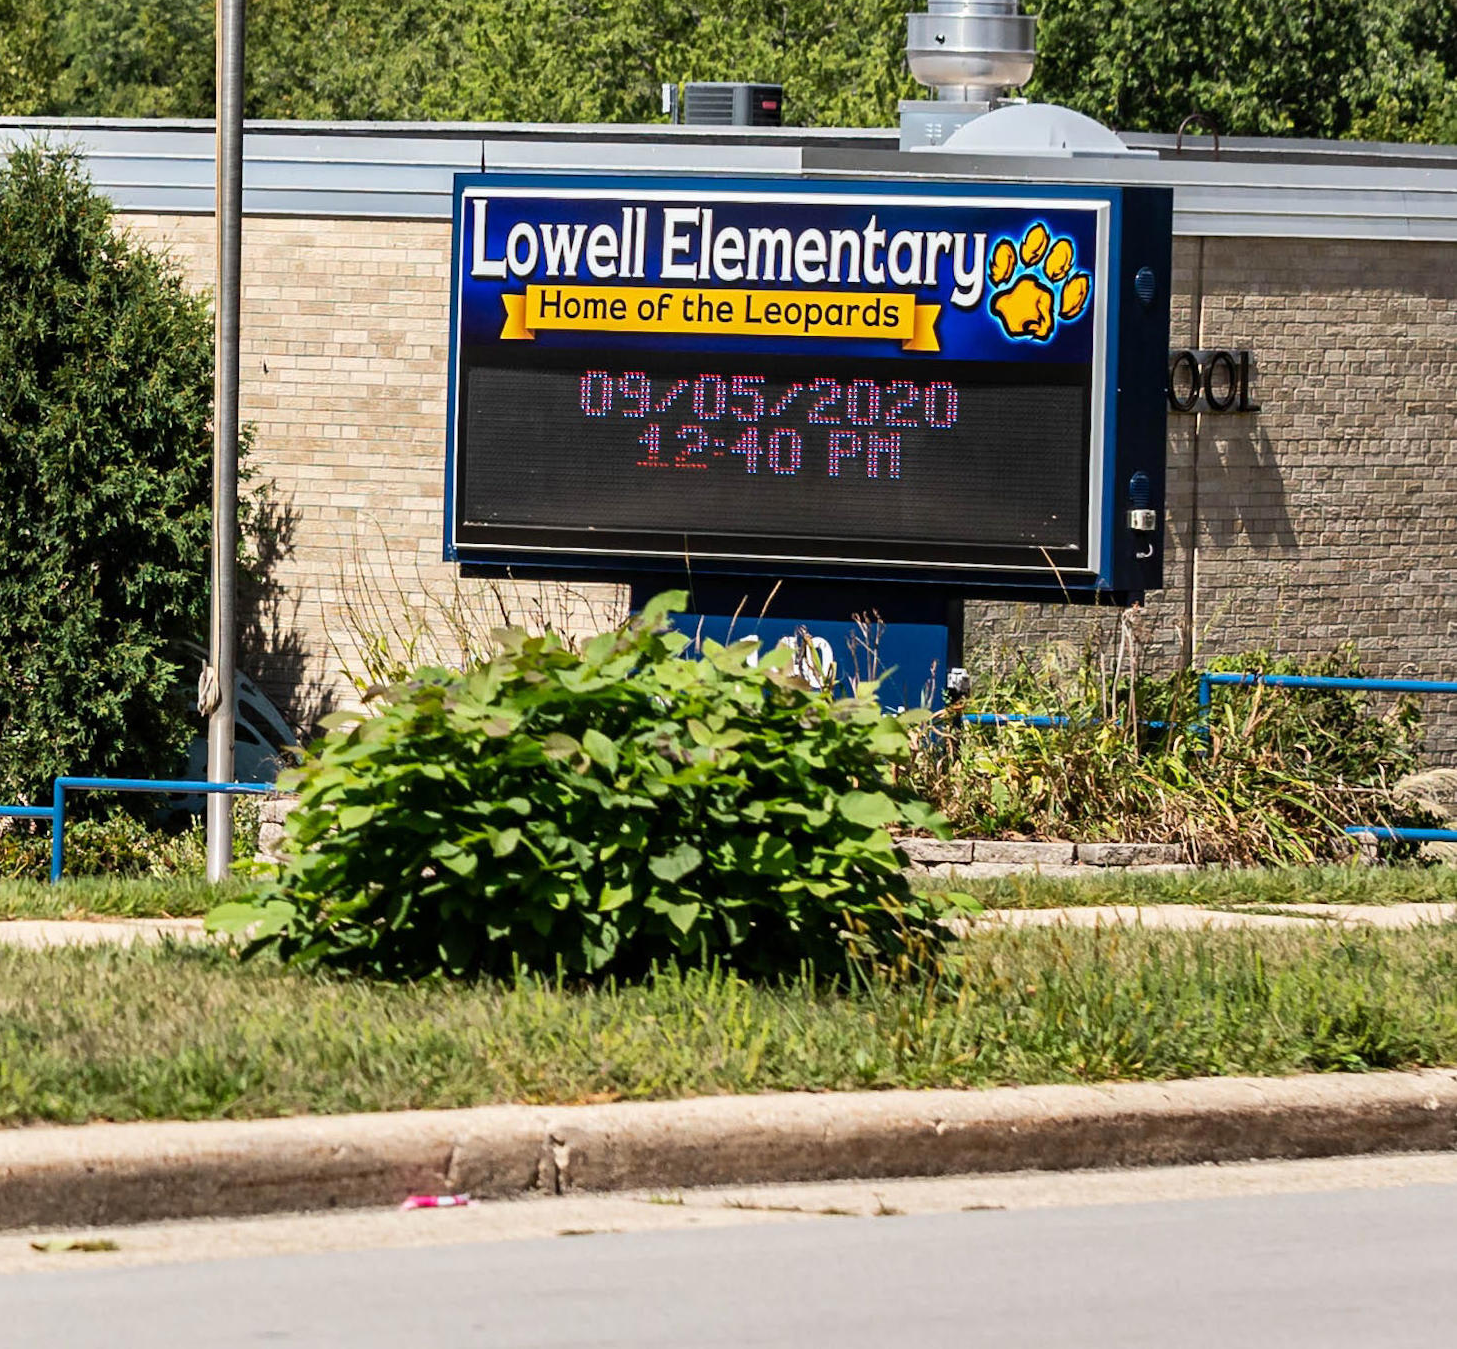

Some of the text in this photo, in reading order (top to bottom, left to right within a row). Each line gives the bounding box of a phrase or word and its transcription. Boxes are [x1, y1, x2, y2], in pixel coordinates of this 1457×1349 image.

[470, 199, 987, 307] Lowell Elementary
[539, 289, 900, 332] Home of the Leopards
[580, 370, 958, 429] 09/05/2020
[636, 423, 901, 480] 12:40 PM
